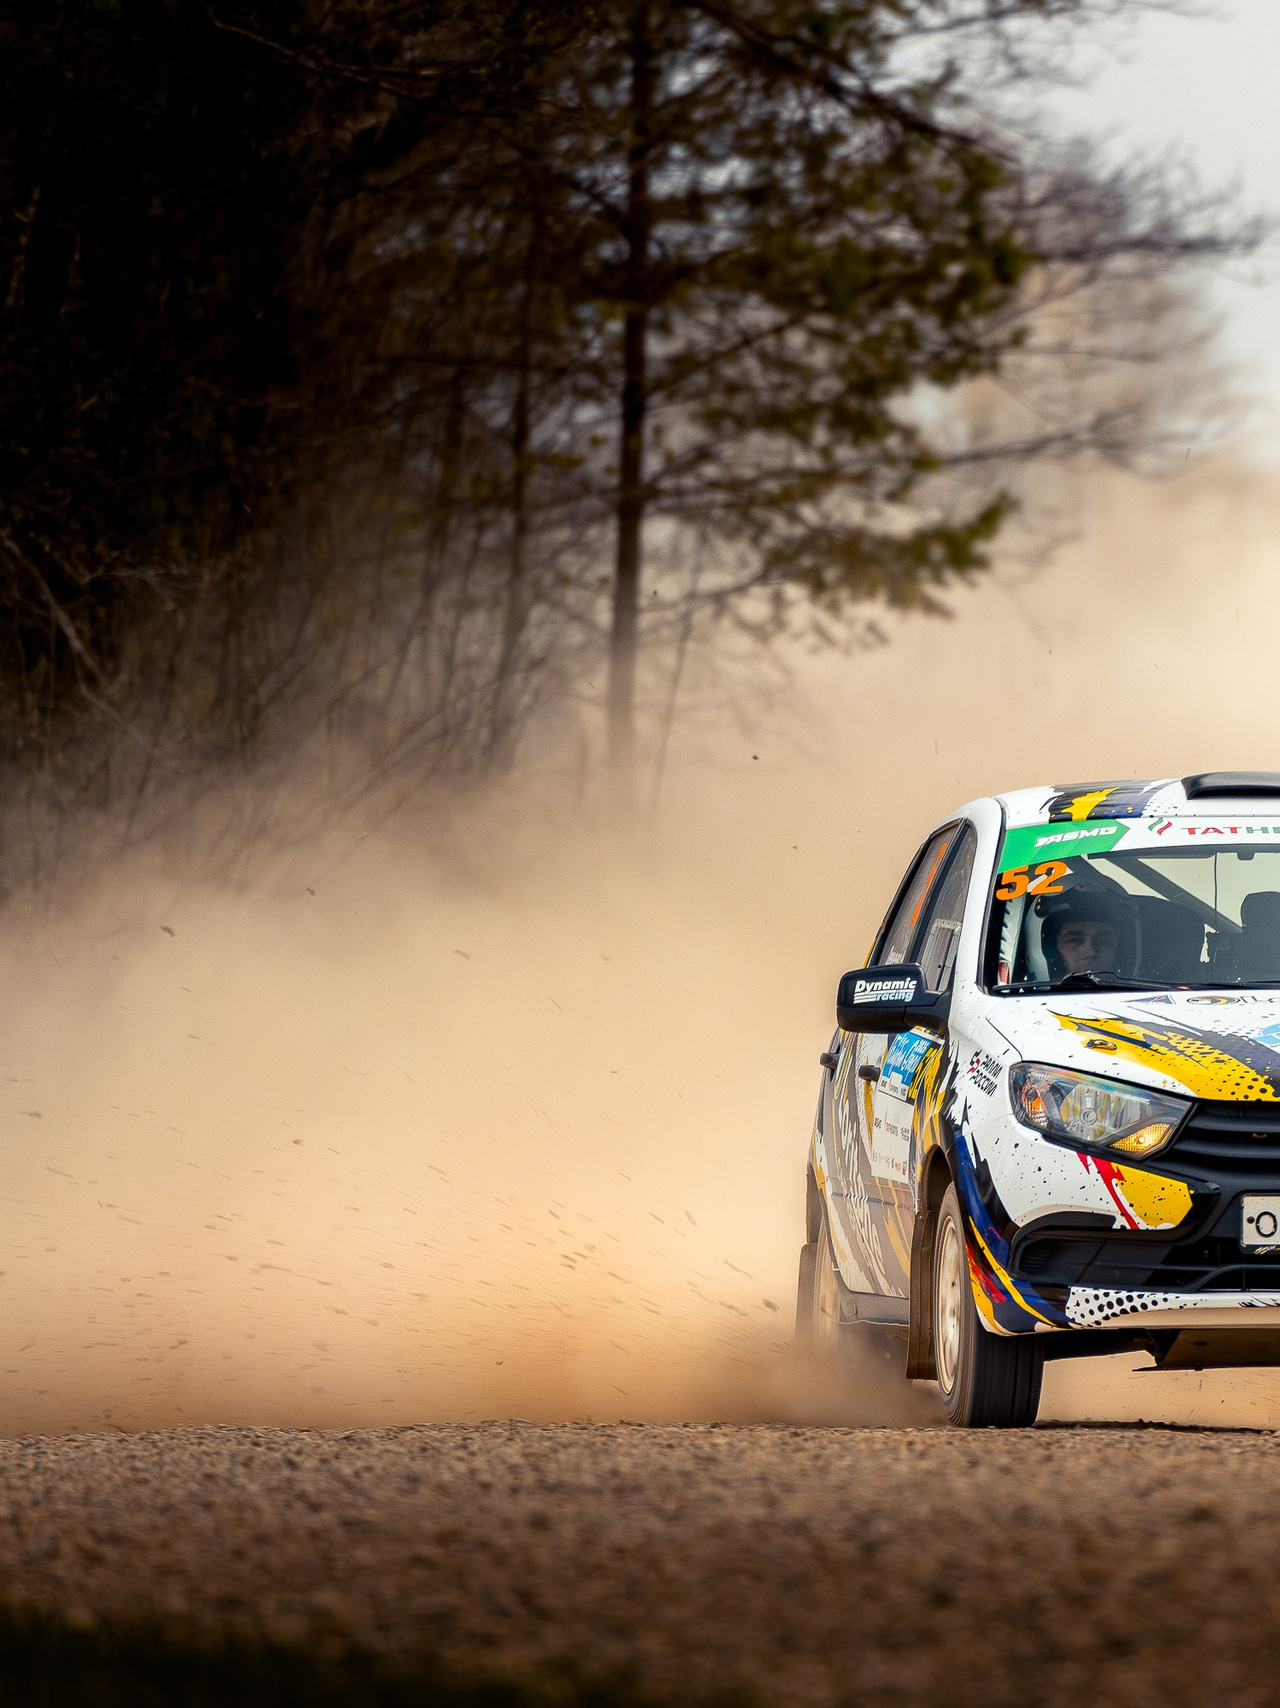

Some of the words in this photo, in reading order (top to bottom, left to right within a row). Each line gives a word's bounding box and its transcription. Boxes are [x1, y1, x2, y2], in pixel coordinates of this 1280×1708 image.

[996, 861, 1067, 901] 52
[855, 977, 917, 994] Dynamic
[876, 991, 913, 1002] racing
[980, 1054, 1003, 1079] РАЛЛИ
[969, 1069, 998, 1097] РОССИИ
